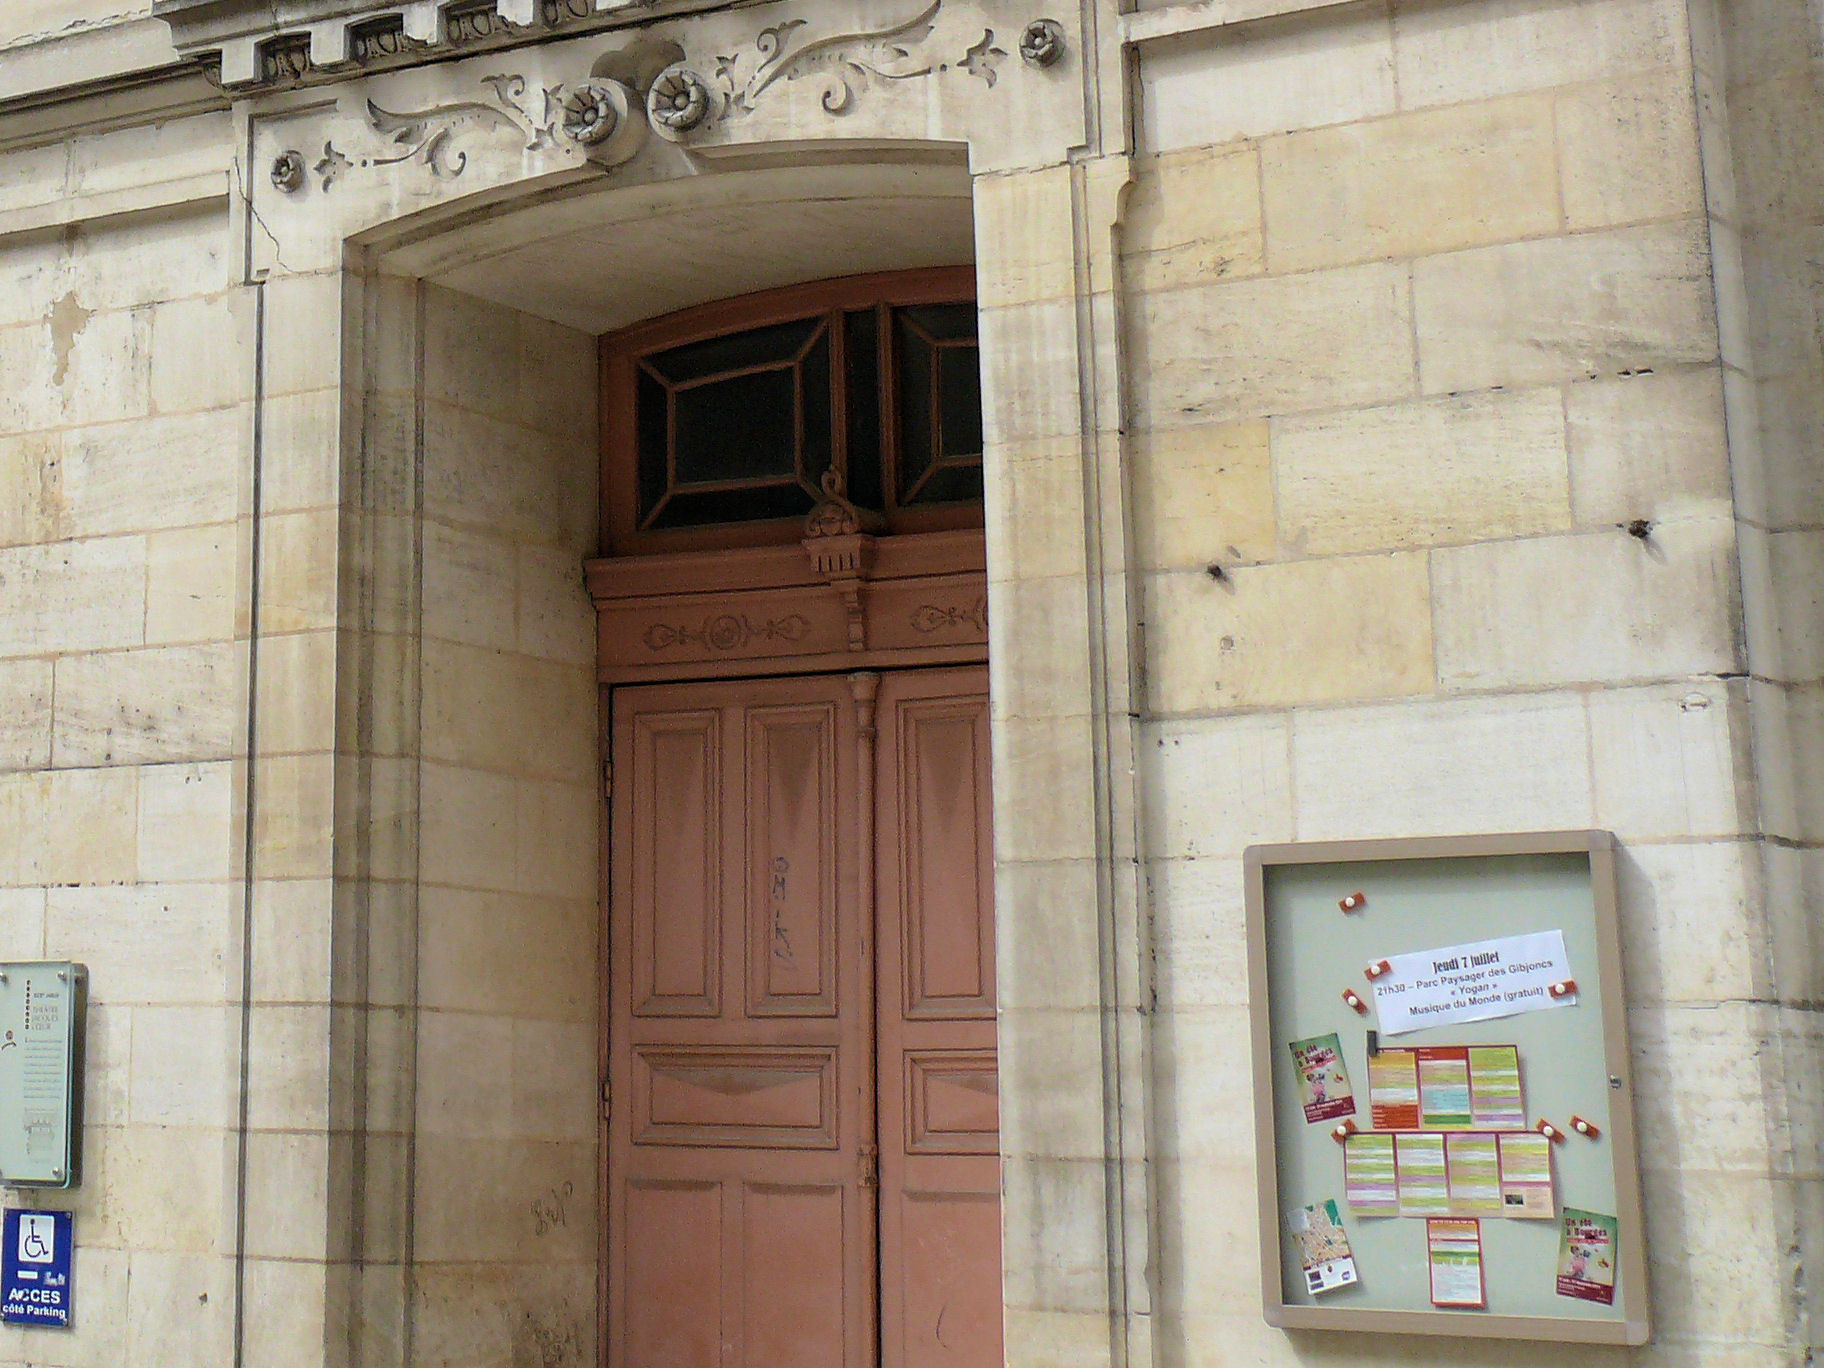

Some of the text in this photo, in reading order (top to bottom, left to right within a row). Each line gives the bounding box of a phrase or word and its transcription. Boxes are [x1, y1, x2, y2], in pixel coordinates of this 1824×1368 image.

[1432, 957, 1459, 974] Jeudi
[1461, 956, 1467, 968] 7
[1377, 983, 1406, 996] 21h30
[1416, 978, 1438, 990] Parc
[1440, 972, 1485, 986] Paysager
[1488, 967, 1506, 978] des
[1508, 960, 1554, 975] Gibjoncs
[1458, 983, 1490, 997] Yogan
[1409, 986, 1545, 1016] Musique du Monde (gratuit)
[8, 1288, 61, 1304] ACCES
[2, 1303, 66, 1319] côté Parking
